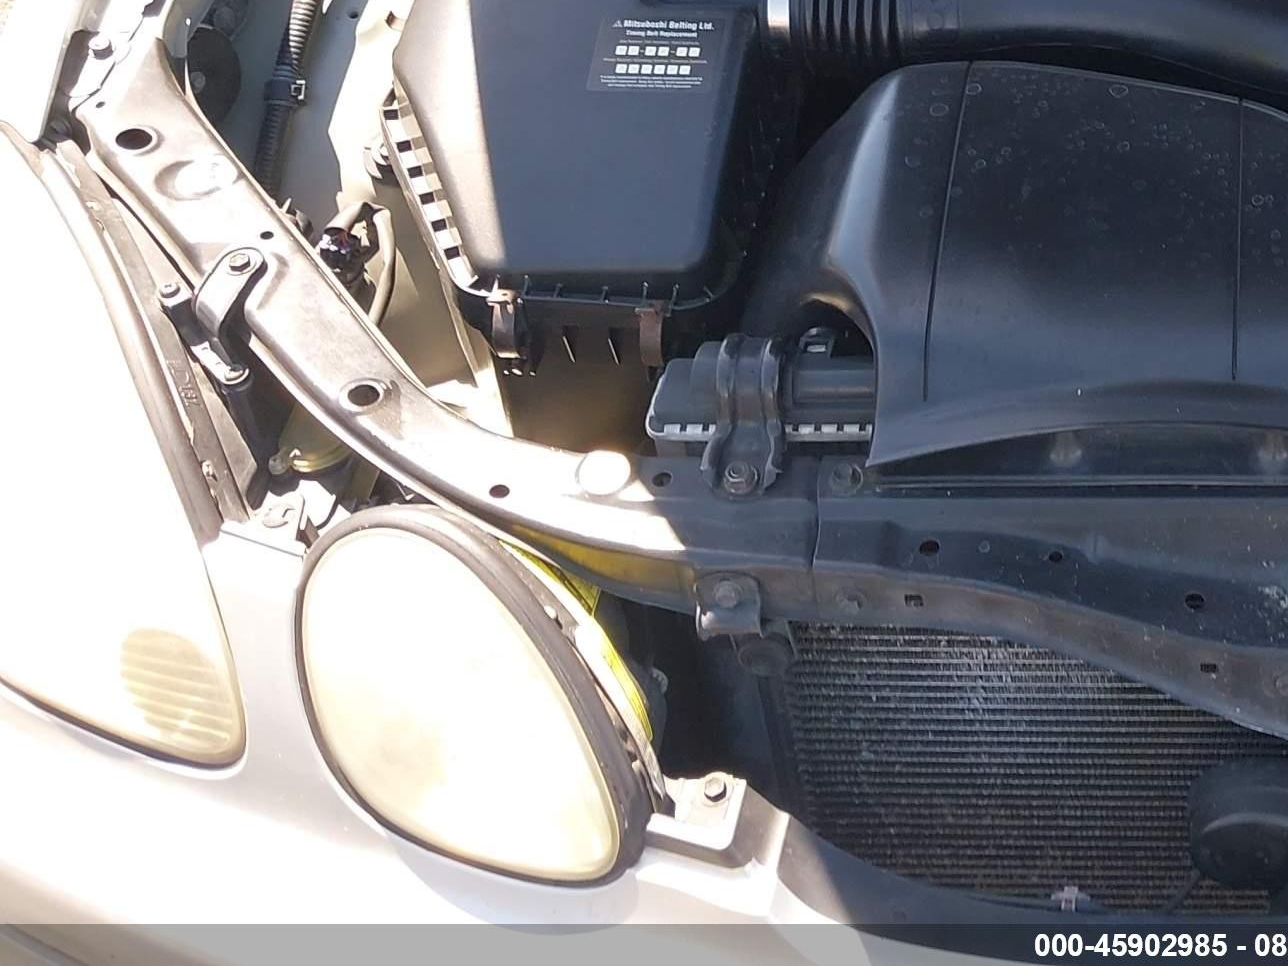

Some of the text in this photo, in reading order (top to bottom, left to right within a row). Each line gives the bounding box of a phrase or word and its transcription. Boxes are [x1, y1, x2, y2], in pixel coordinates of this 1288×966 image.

[623, 19, 715, 31] Mitsuboshi Belting Ltd.
